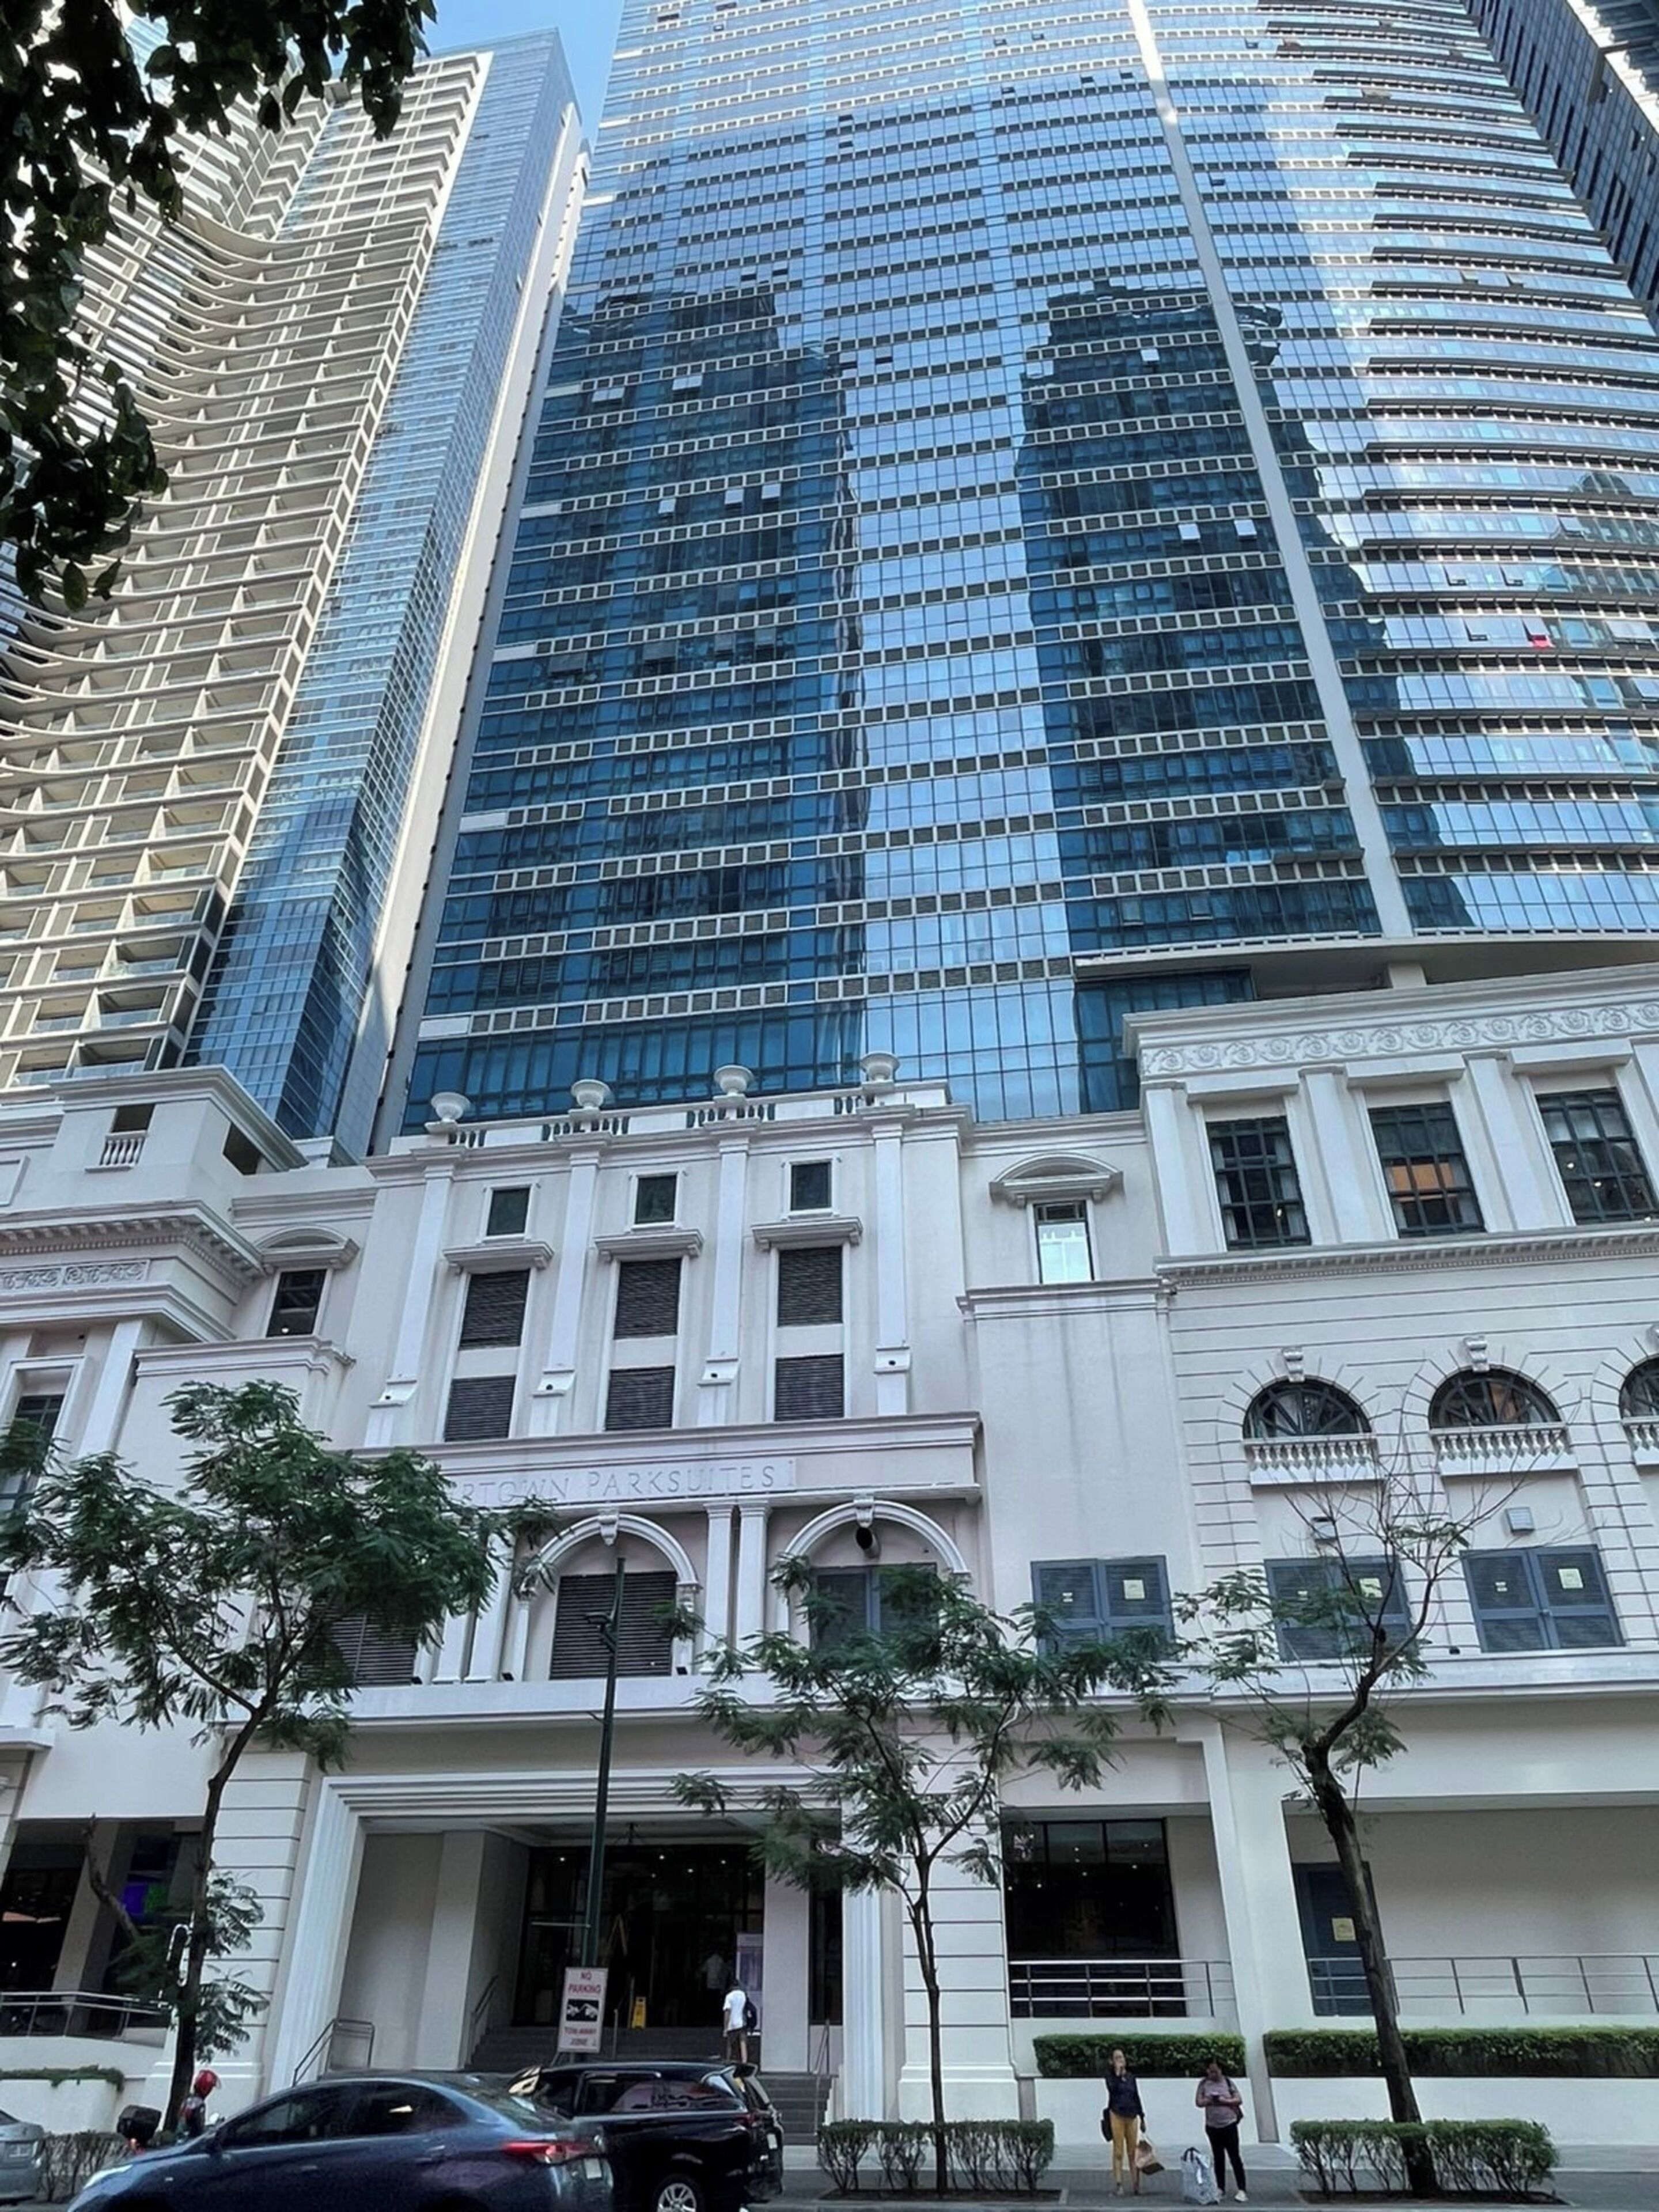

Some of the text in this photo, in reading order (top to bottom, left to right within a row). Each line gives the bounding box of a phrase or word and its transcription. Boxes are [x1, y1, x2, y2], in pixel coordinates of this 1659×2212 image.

[587, 1465, 775, 1497] PARKSUITES
[581, 1970, 592, 1981] NO
[569, 1983, 601, 1993] PARKING
